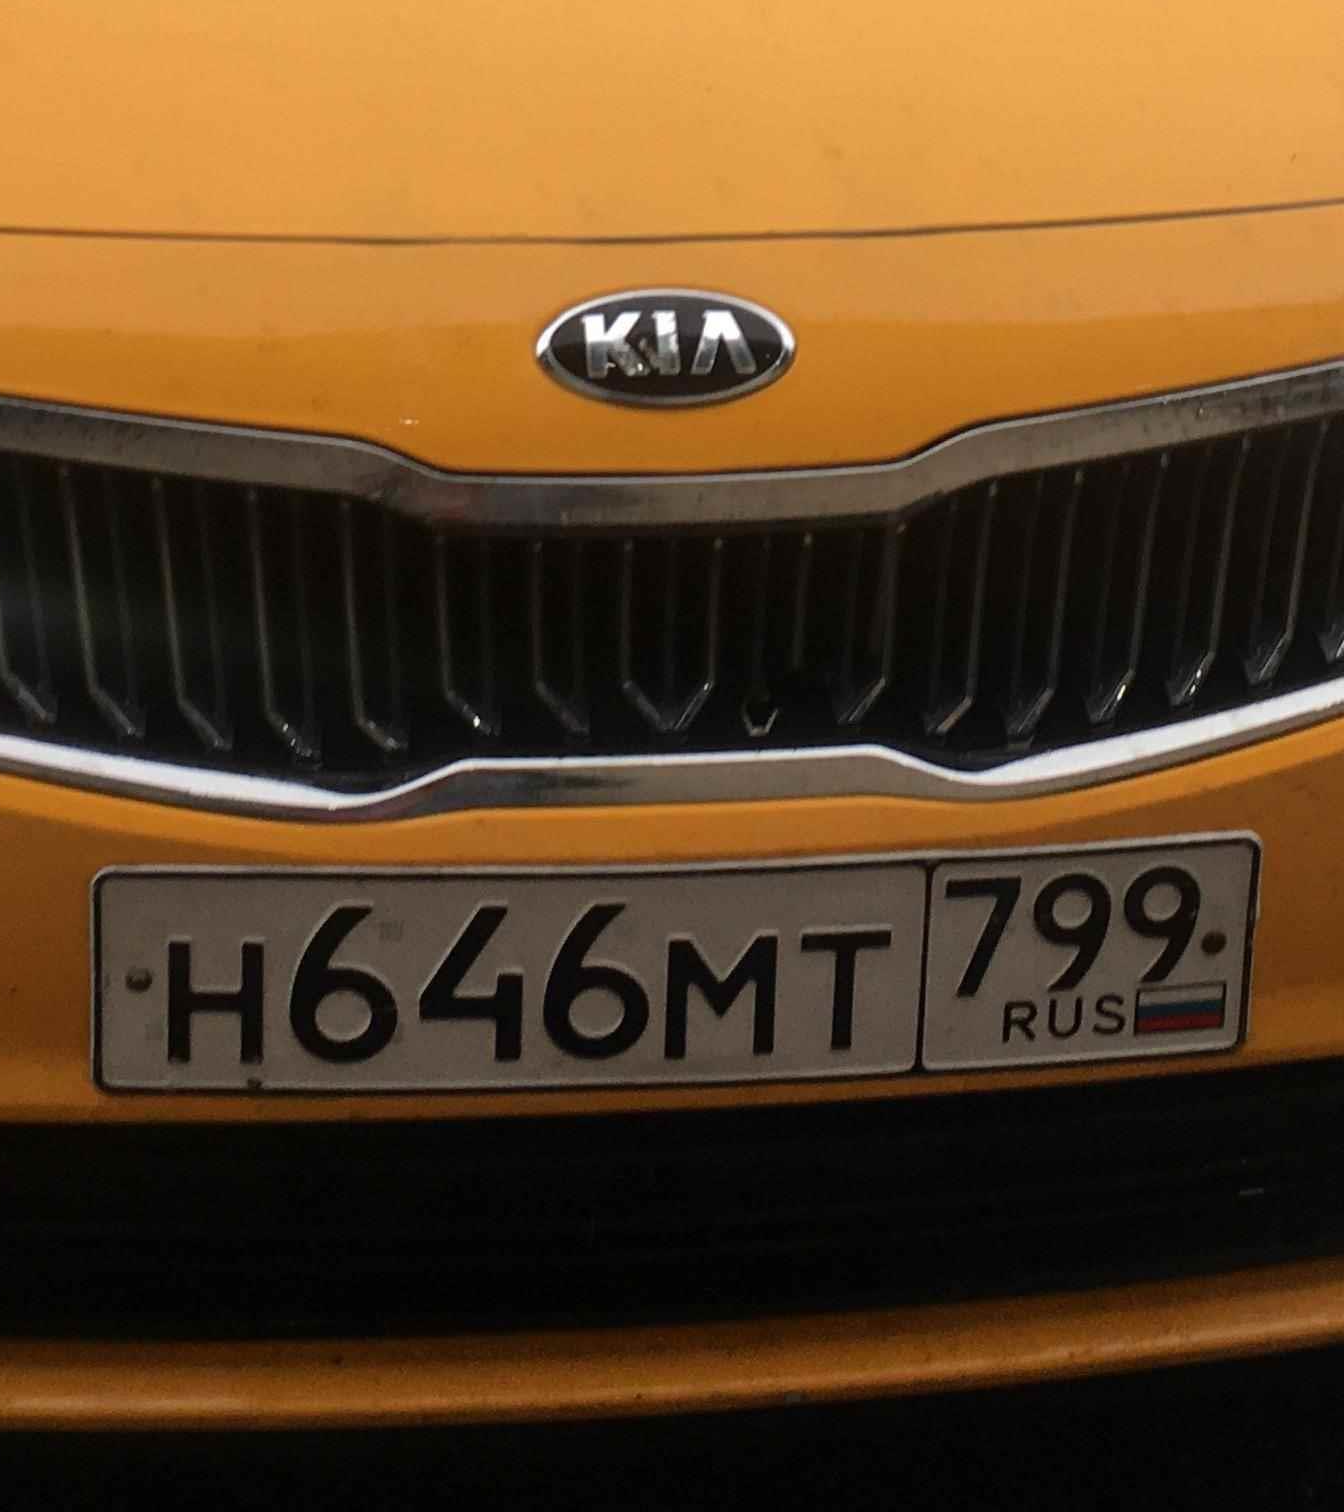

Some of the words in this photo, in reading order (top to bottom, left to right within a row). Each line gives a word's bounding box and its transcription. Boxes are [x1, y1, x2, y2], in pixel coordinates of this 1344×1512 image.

[581, 309, 757, 379] KIA
[942, 866, 1204, 997] 799
[1000, 992, 1128, 1044] RUS
